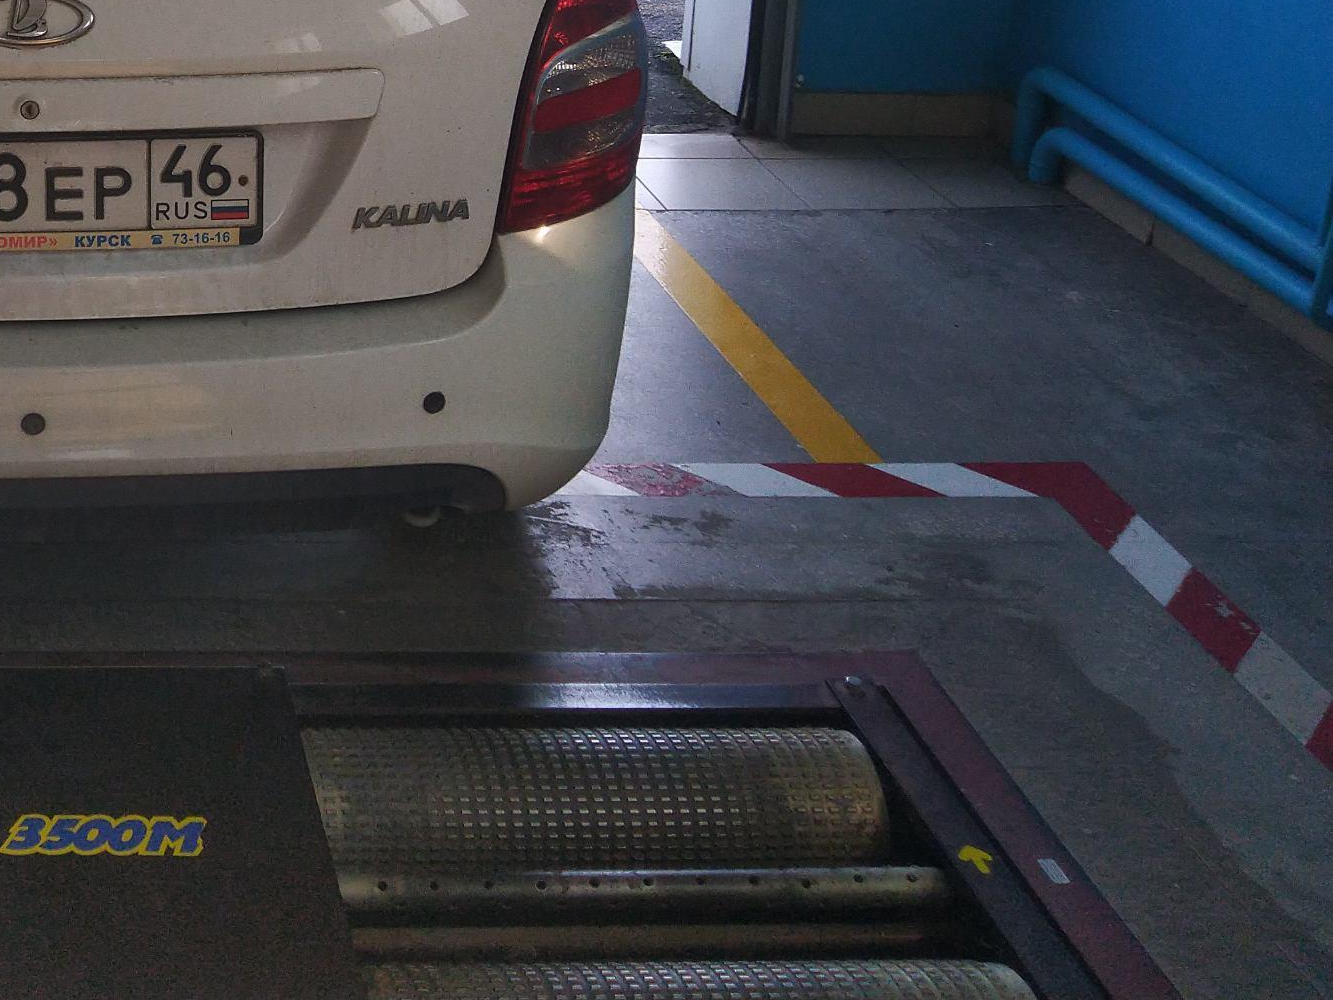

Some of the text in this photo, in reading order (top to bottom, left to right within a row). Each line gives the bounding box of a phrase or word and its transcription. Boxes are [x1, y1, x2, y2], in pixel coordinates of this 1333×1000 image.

[160, 144, 232, 198] 46
[154, 200, 209, 221] RUS
[351, 198, 470, 230] KALINA
[74, 234, 132, 247] КУРСК
[172, 231, 231, 246] 73-16-16
